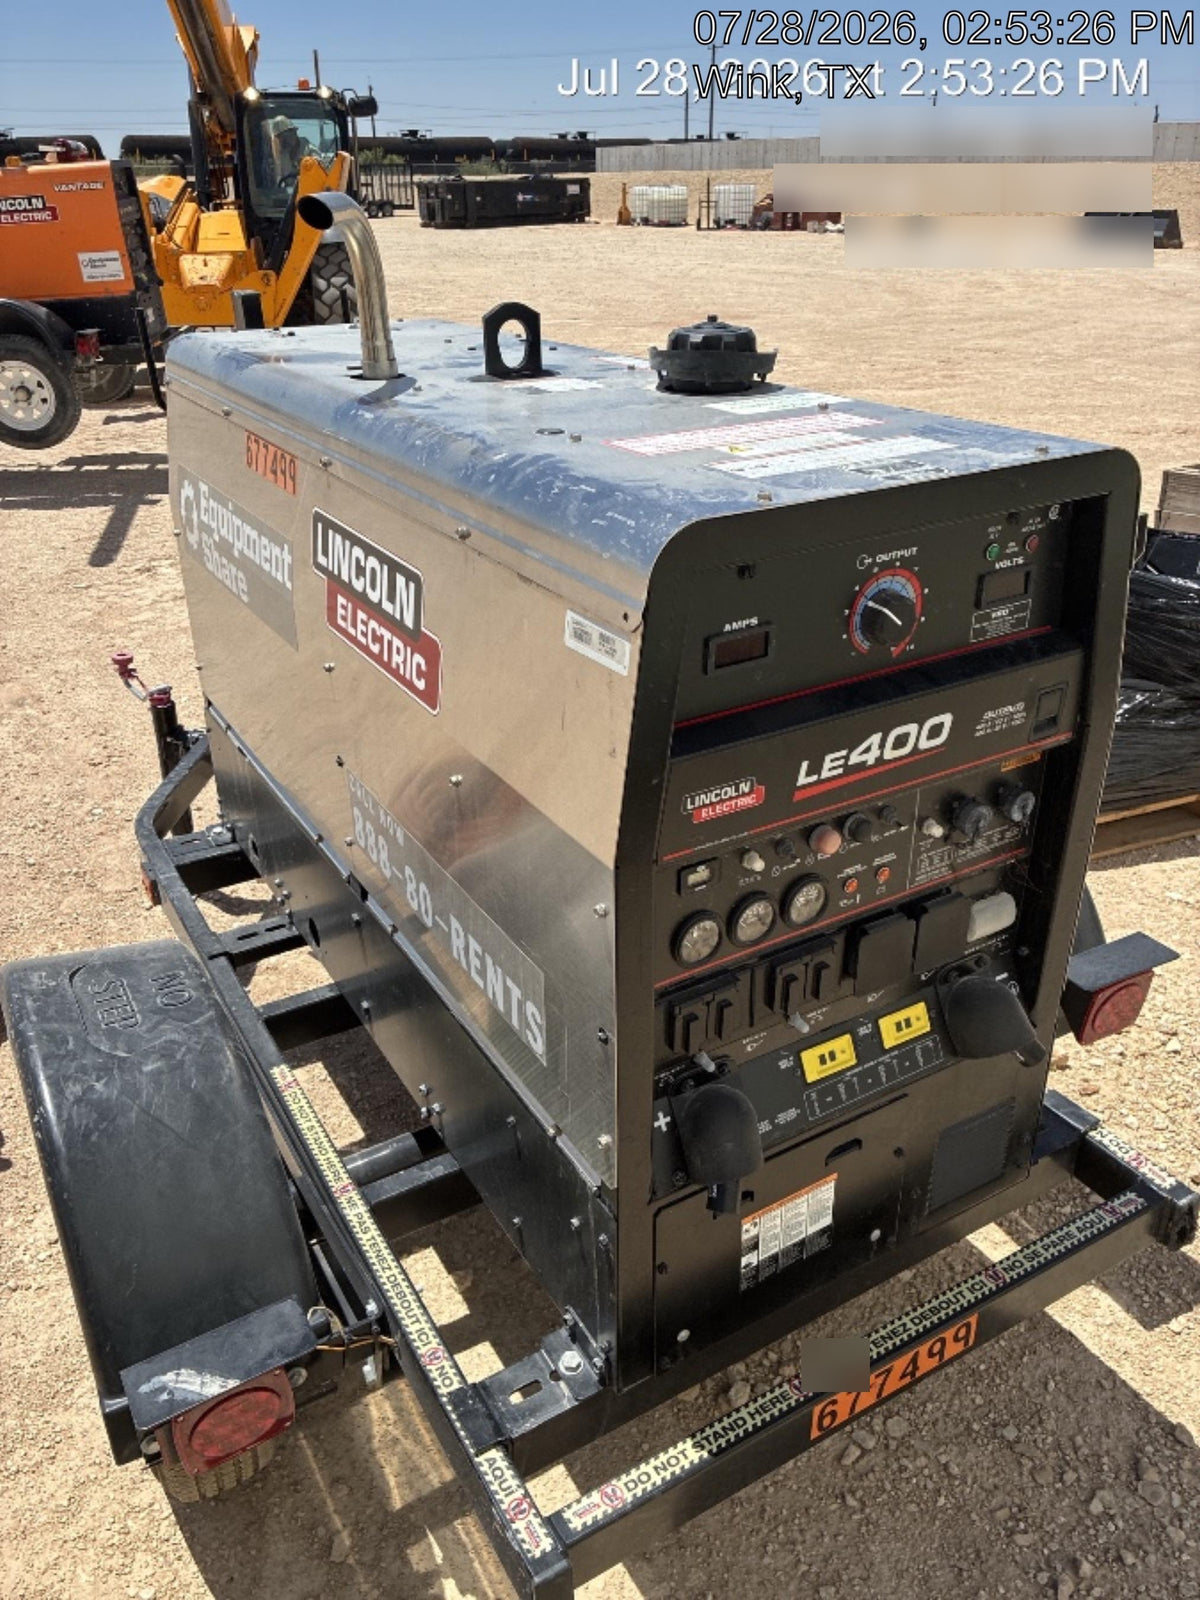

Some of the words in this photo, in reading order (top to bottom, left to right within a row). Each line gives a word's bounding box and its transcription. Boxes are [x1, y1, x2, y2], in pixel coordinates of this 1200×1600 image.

[1, 211, 53, 223] ELECTRIC
[245, 429, 297, 496] 677499
[198, 482, 292, 591] Equipment
[202, 534, 250, 604] Share
[875, 547, 918, 562] OUTPUT
[316, 522, 416, 630] LINCOLN
[336, 593, 427, 691] ELECTRIC
[723, 616, 759, 632] AMPS
[795, 712, 954, 787] LE400
[684, 781, 753, 810] LINCOLN
[701, 793, 757, 820] ELECTRIC
[88, 978, 142, 1030] STEP
[354, 1211, 372, 1234] PAS
[365, 1234, 392, 1273] TENEZ
[386, 1272, 423, 1329] DEBOUT
[415, 1324, 432, 1348] ICI
[1003, 1260, 1024, 1276] NO
[1023, 1248, 1045, 1264] SE
[1043, 1230, 1076, 1255] PARE
[869, 1319, 913, 1350] ENEZ
[911, 1291, 967, 1327] DEBOUT
[968, 1279, 988, 1295] ICI
[435, 1364, 455, 1389] NO
[816, 1318, 973, 1434] 677499
[623, 1470, 652, 1493] DO
[653, 1449, 690, 1477] NOT
[691, 1415, 749, 1452] STAND
[747, 1391, 793, 1421] HERE
